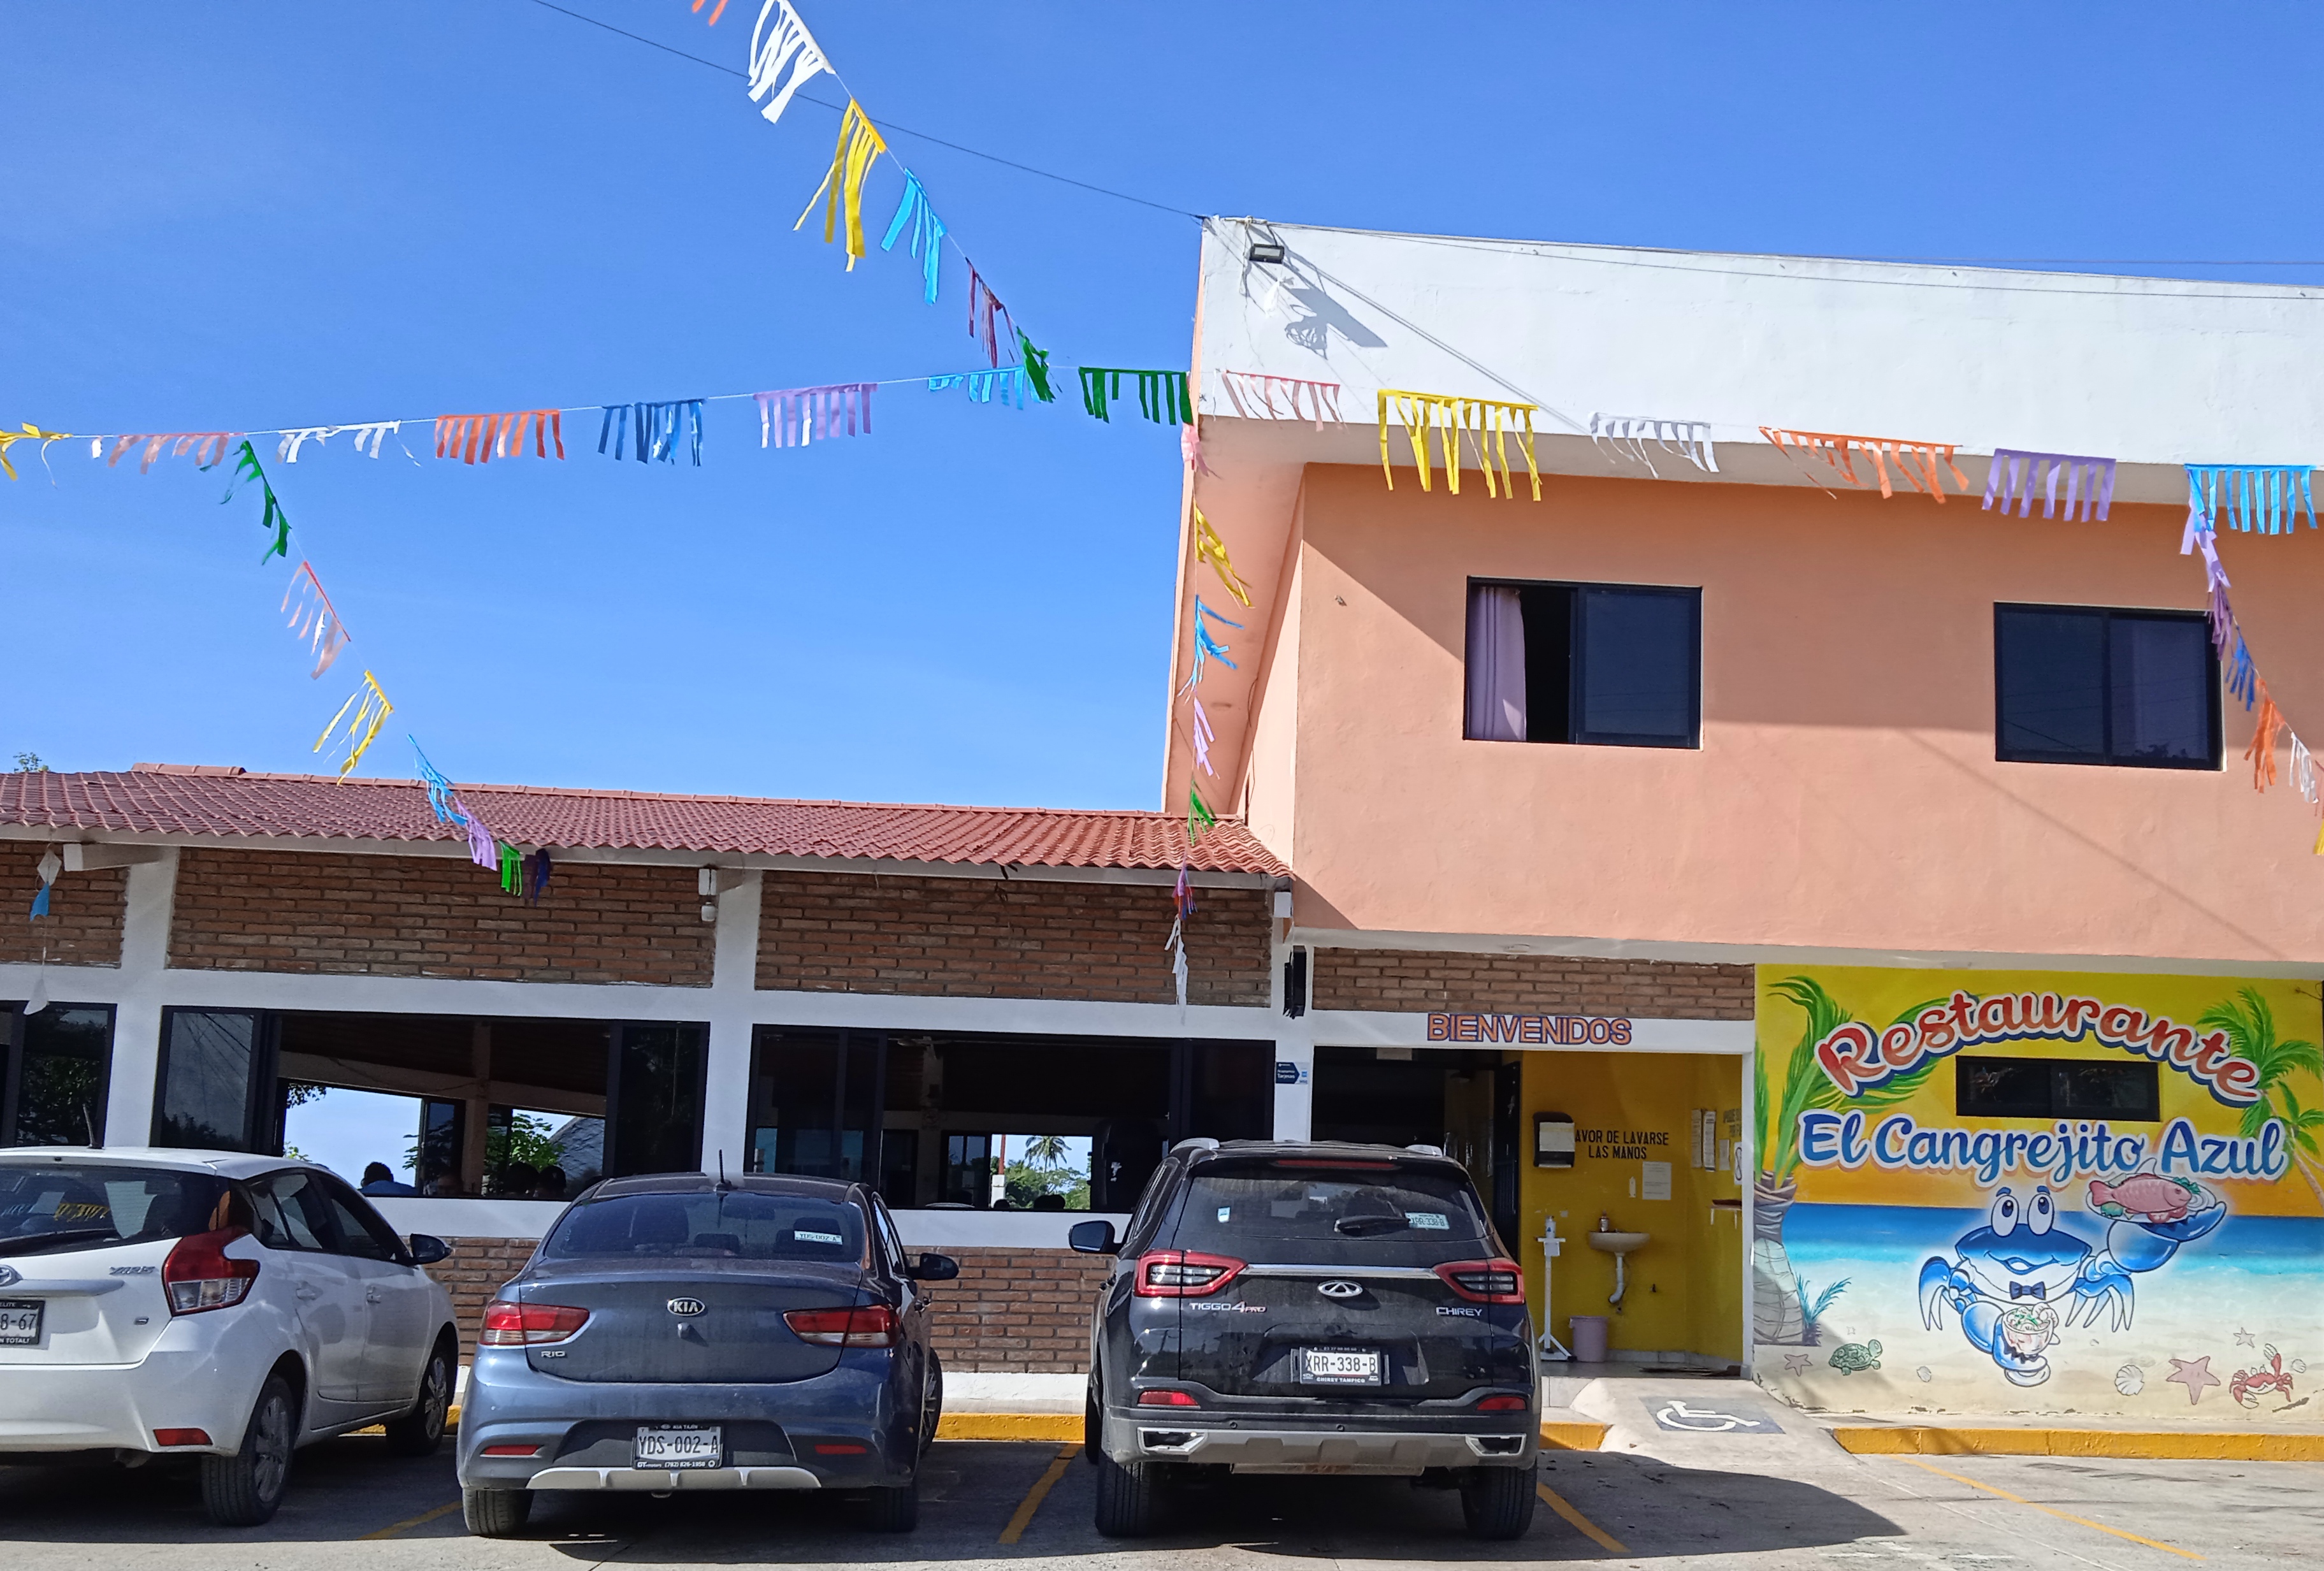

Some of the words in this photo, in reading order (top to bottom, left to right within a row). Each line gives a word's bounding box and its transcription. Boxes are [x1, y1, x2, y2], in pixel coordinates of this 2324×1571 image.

[1427, 1013, 1632, 1045] BIENVENIDOS
[1816, 992, 2263, 1101] Restaurante
[1575, 1129, 1603, 1143] AVOR
[1606, 1131, 1619, 1143] DE
[1623, 1131, 1669, 1145] LAVARSE
[1589, 1145, 1609, 1159] LAS
[1612, 1146, 1647, 1159] MANOS
[1802, 1114, 1866, 1166] El
[1876, 1113, 2146, 1183] Cangrejito
[2163, 1120, 2285, 1176] Azul
[674, 1301, 698, 1312] KIA
[1436, 1307, 1483, 1317] CHIREY
[1306, 1355, 1376, 1373] XRR-338-B
[639, 1435, 718, 1454] YDS-002-A
